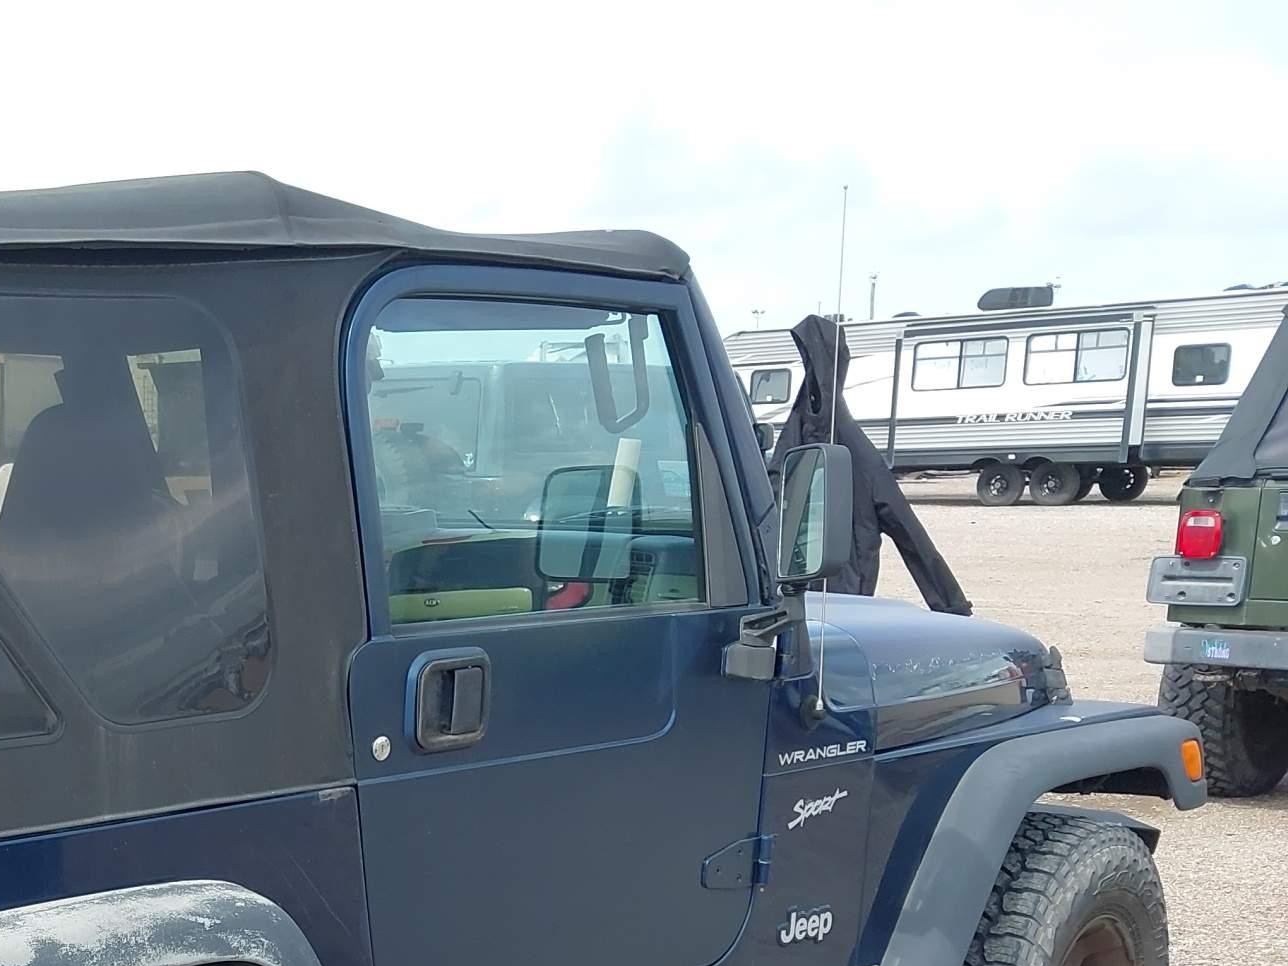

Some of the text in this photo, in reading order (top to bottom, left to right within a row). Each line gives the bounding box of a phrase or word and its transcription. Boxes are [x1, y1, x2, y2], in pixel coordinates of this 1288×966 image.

[956, 410, 1072, 424] TRAIL RUNNER
[778, 740, 867, 766] WRANGLER
[788, 788, 848, 829] Sport
[780, 911, 833, 944] Jeep
